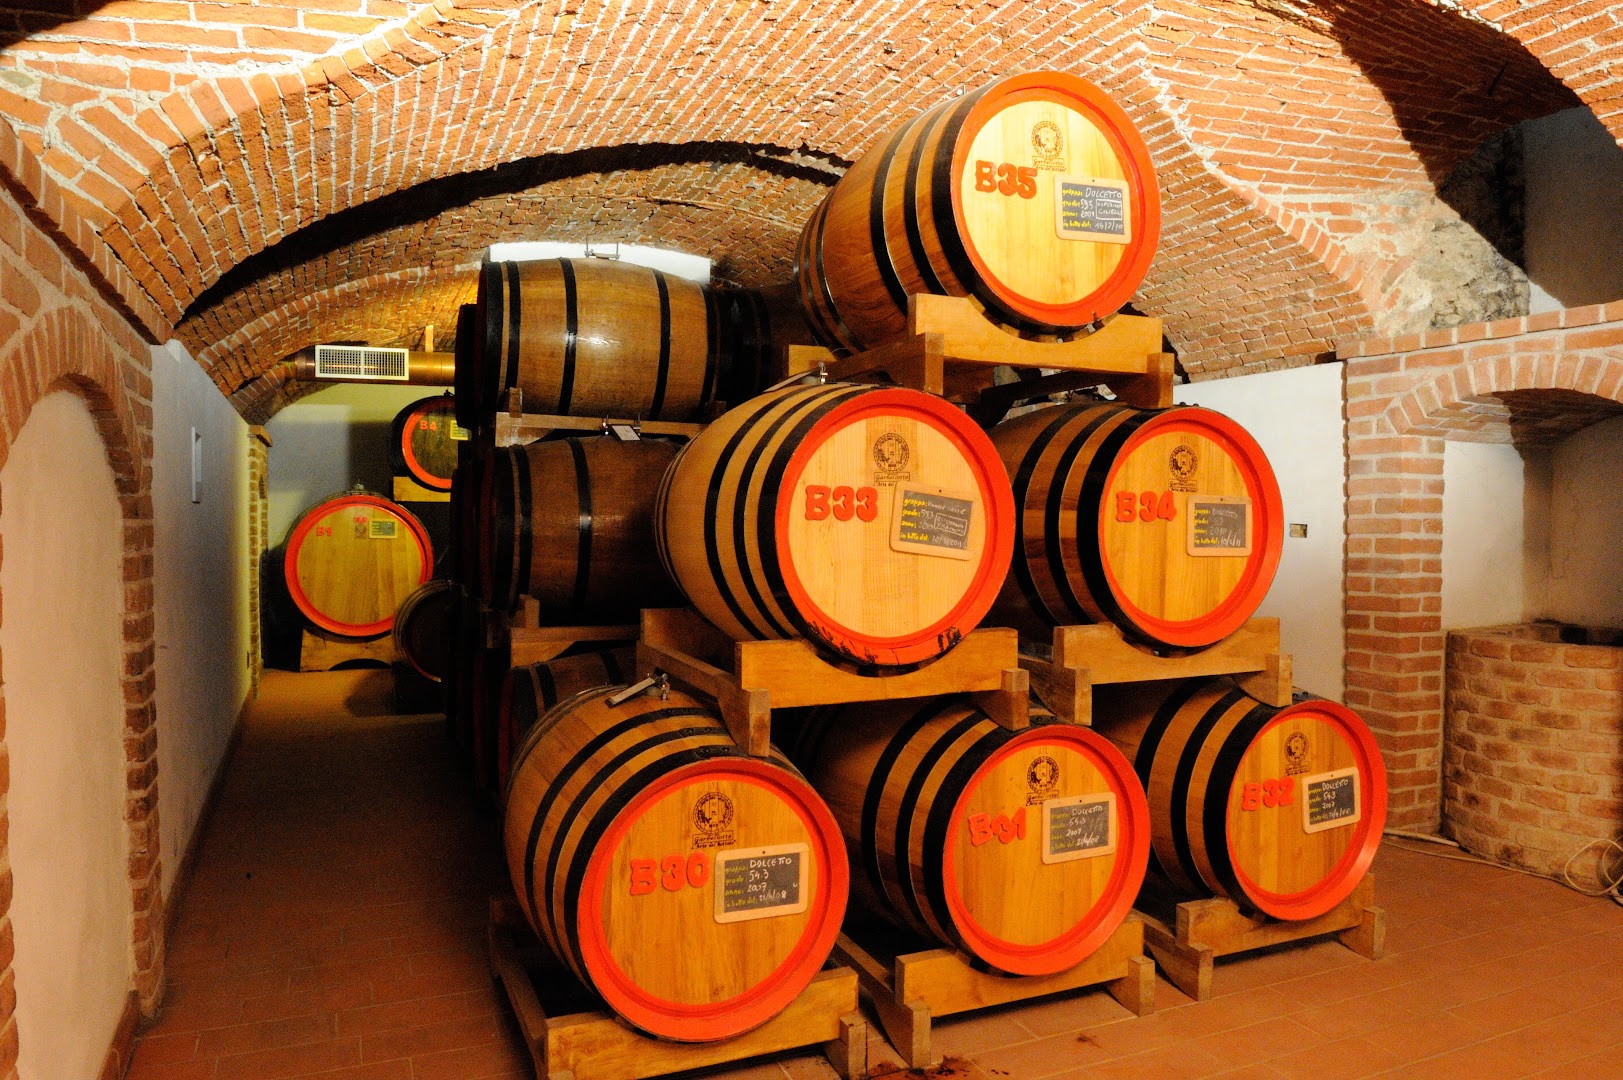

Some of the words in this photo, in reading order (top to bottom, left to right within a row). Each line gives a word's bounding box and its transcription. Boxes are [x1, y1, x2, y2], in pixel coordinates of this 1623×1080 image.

[975, 160, 1038, 199] B35
[1085, 187, 1122, 198] DOLCETTO
[805, 484, 878, 522] B33
[1116, 490, 1177, 522] B34
[1242, 776, 1295, 811] B32
[630, 851, 710, 896] B30
[749, 856, 792, 869] DOLCETTO
